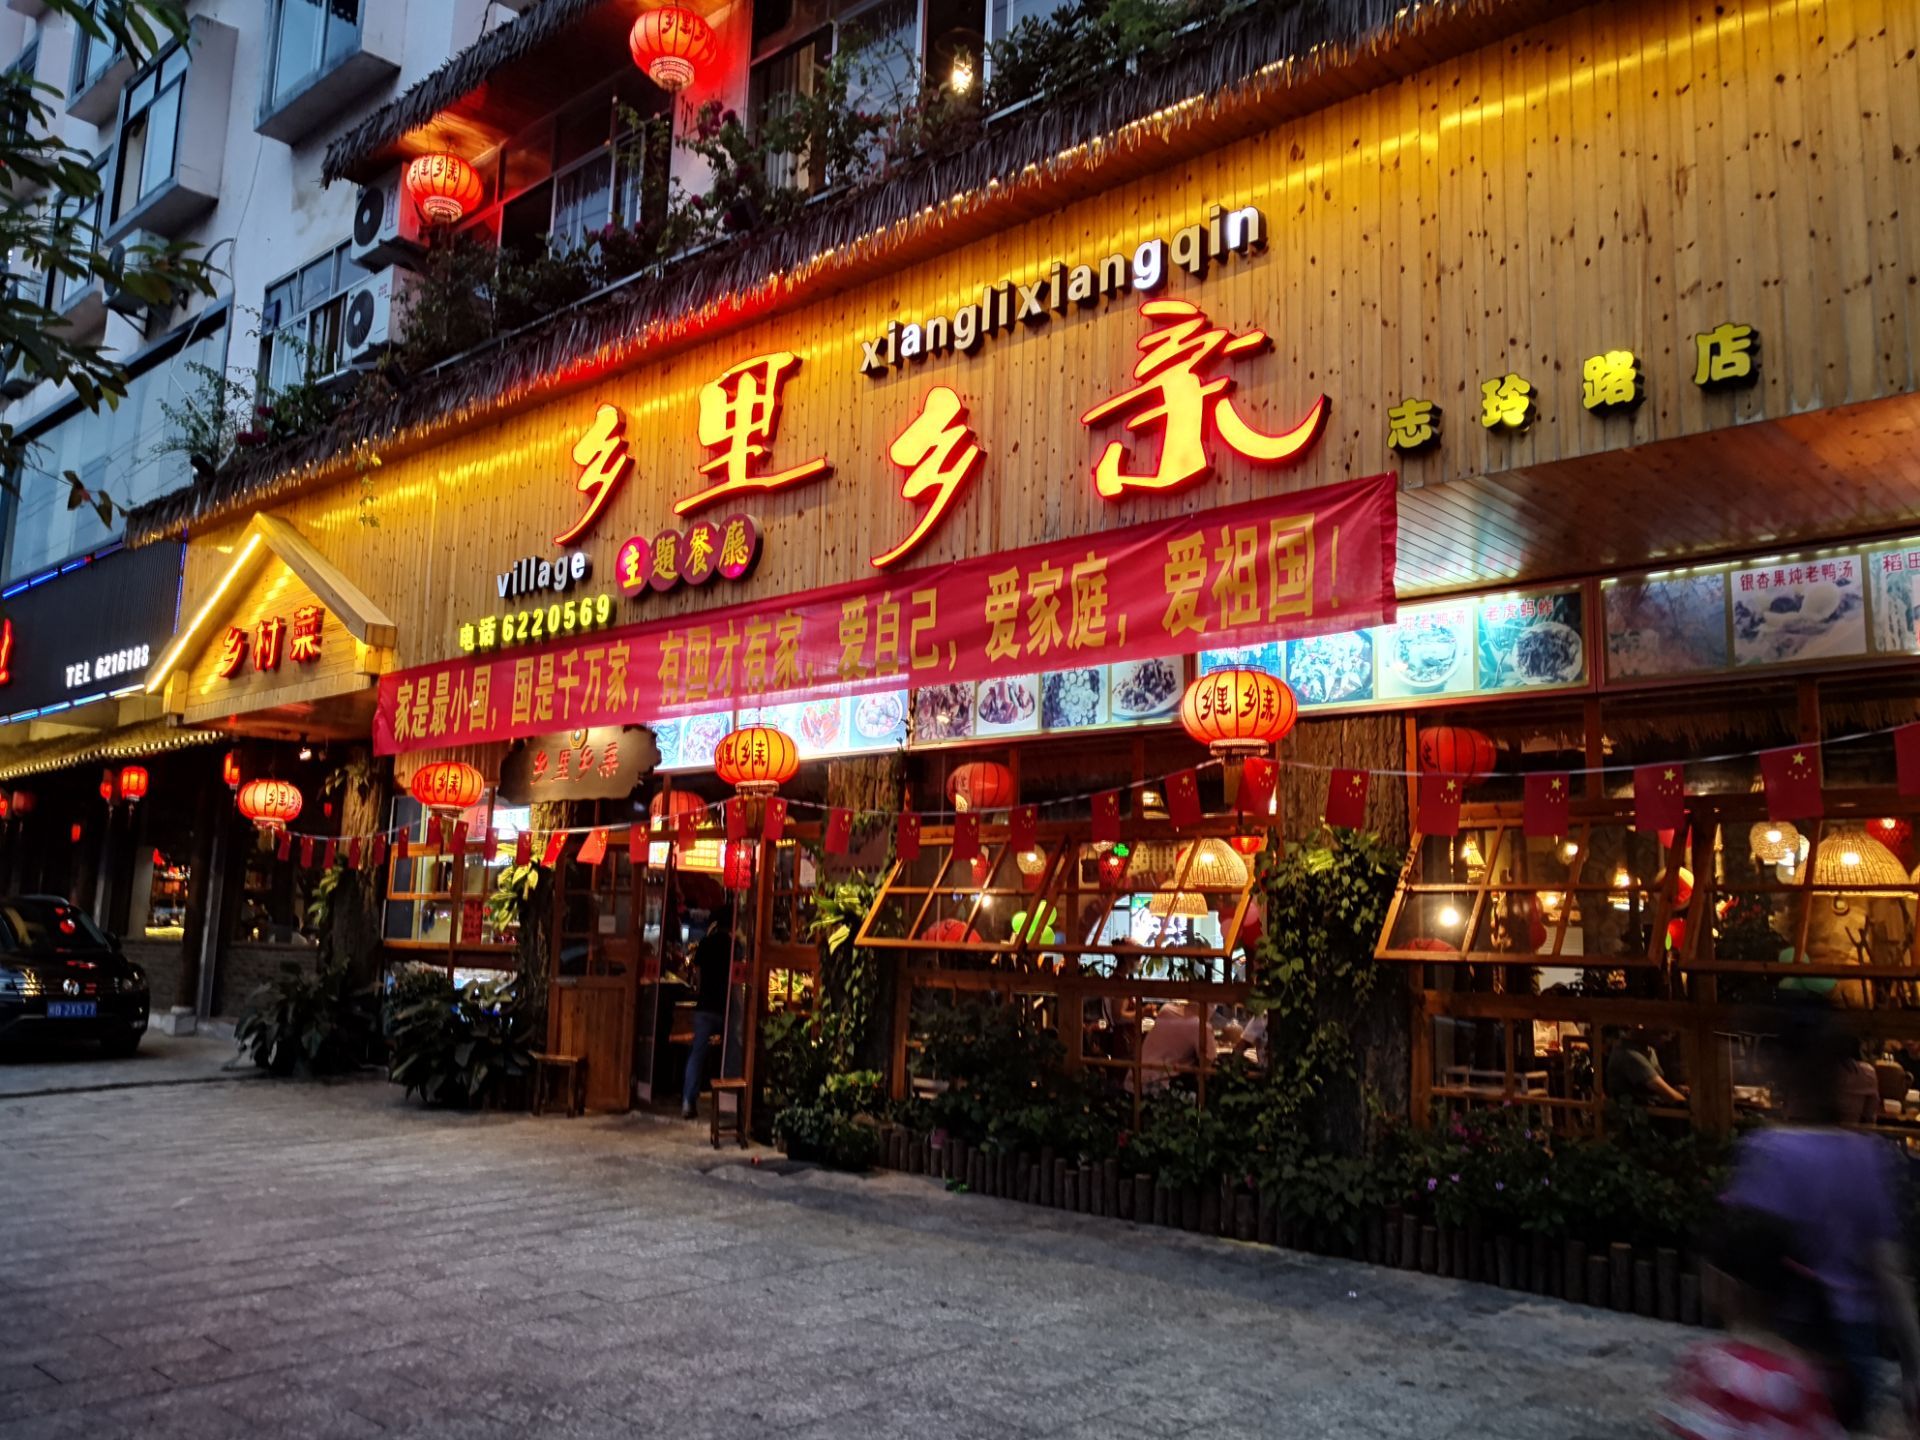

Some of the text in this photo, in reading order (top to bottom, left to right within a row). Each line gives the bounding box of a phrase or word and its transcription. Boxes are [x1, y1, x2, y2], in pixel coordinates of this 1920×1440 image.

[860, 204, 1263, 374] xianglixiangqin
[1387, 322, 1757, 449] 志玲路店
[496, 551, 588, 599] village
[219, 605, 324, 678] 乡村菜
[459, 593, 611, 651] 电话 6220569
[65, 644, 150, 689] TEL 6216188
